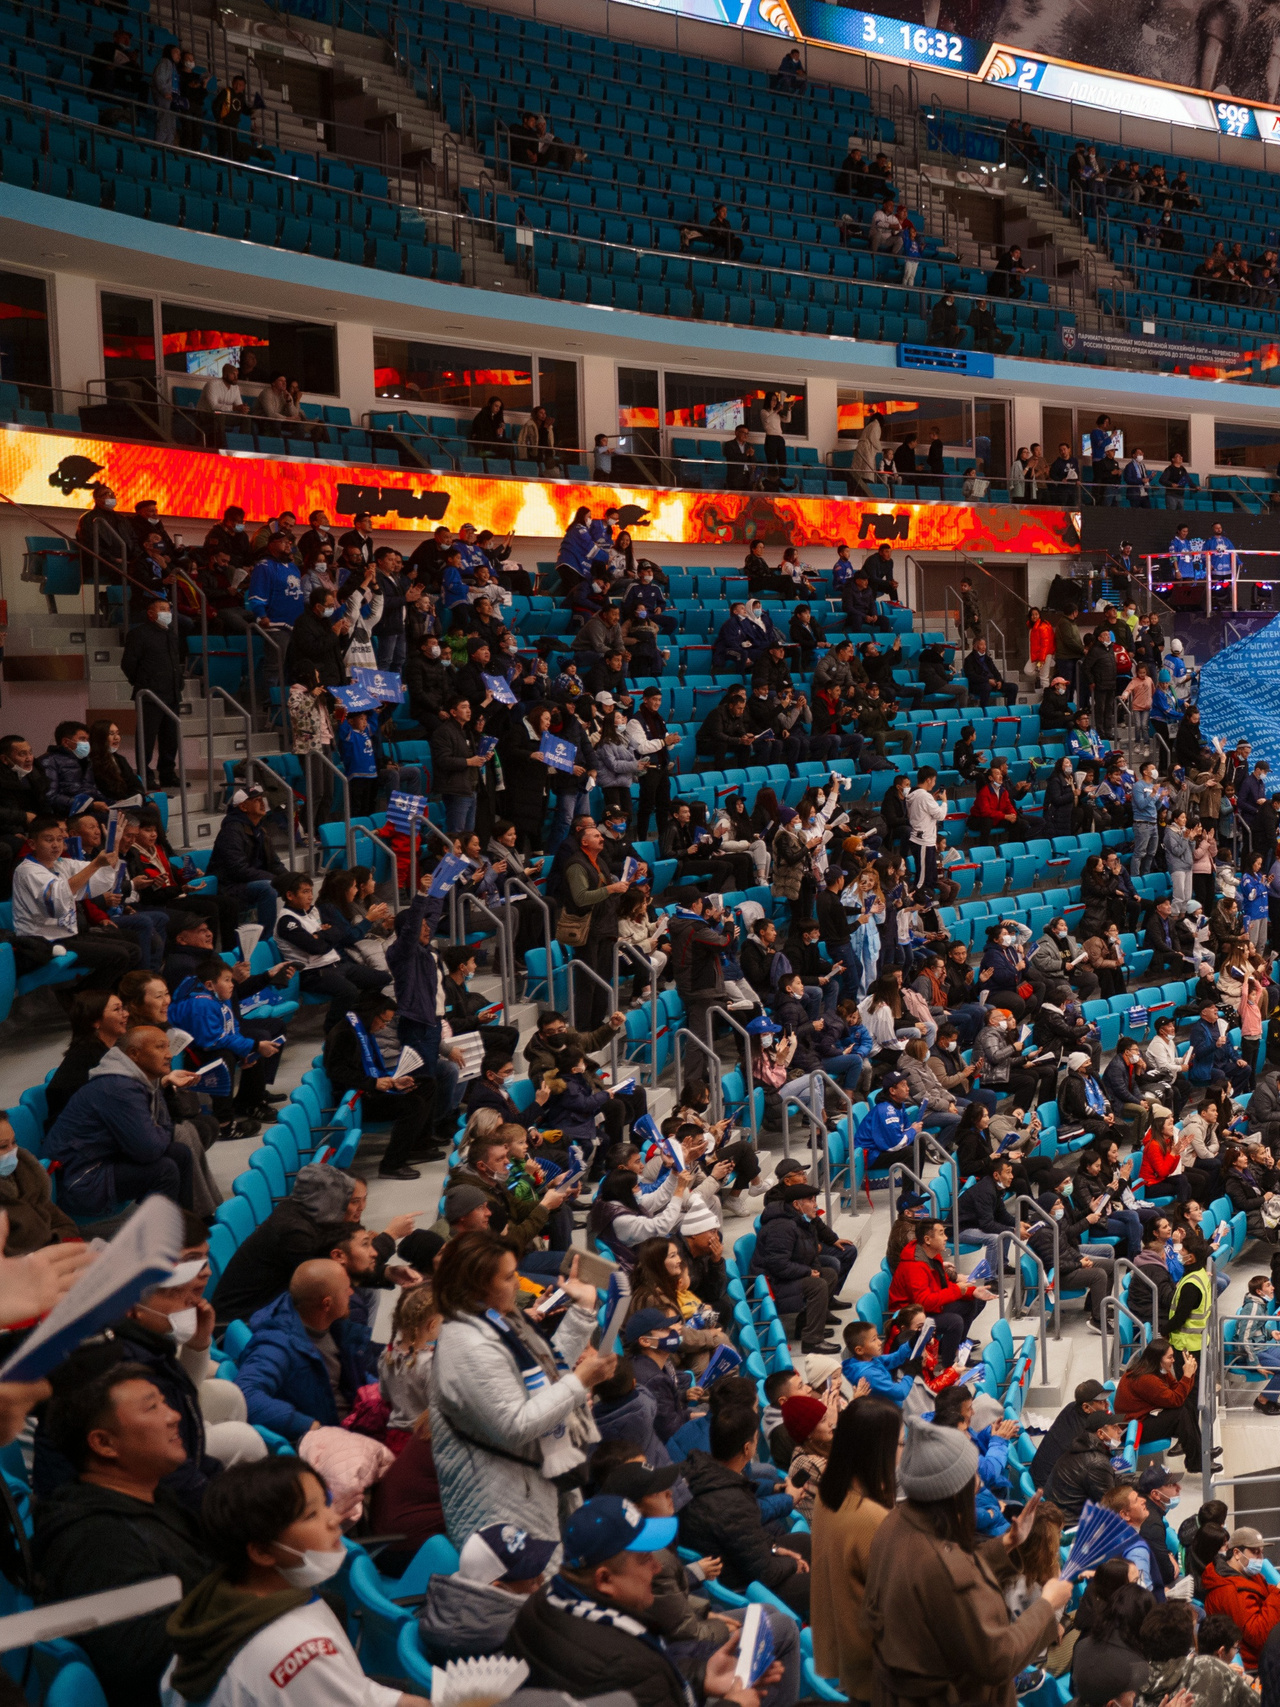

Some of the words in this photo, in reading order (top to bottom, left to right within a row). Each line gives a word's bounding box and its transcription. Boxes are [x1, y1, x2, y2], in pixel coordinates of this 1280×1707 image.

[862, 17, 884, 43] 3.
[900, 25, 963, 62] 16:32
[1018, 62, 1038, 90] 2
[1218, 103, 1250, 122] SOG
[1078, 333, 1104, 341] ПАРИМАТЧ
[1105, 336, 1133, 345] ЧЕМПИОНАТ
[1212, 349, 1239, 357] ПЕРВЕНСТВО
[1111, 344, 1131, 352] ХОККЕЮ
[1148, 348, 1171, 358] ЮНИОРОВ
[1226, 662, 1249, 670] ОЛЕГ
